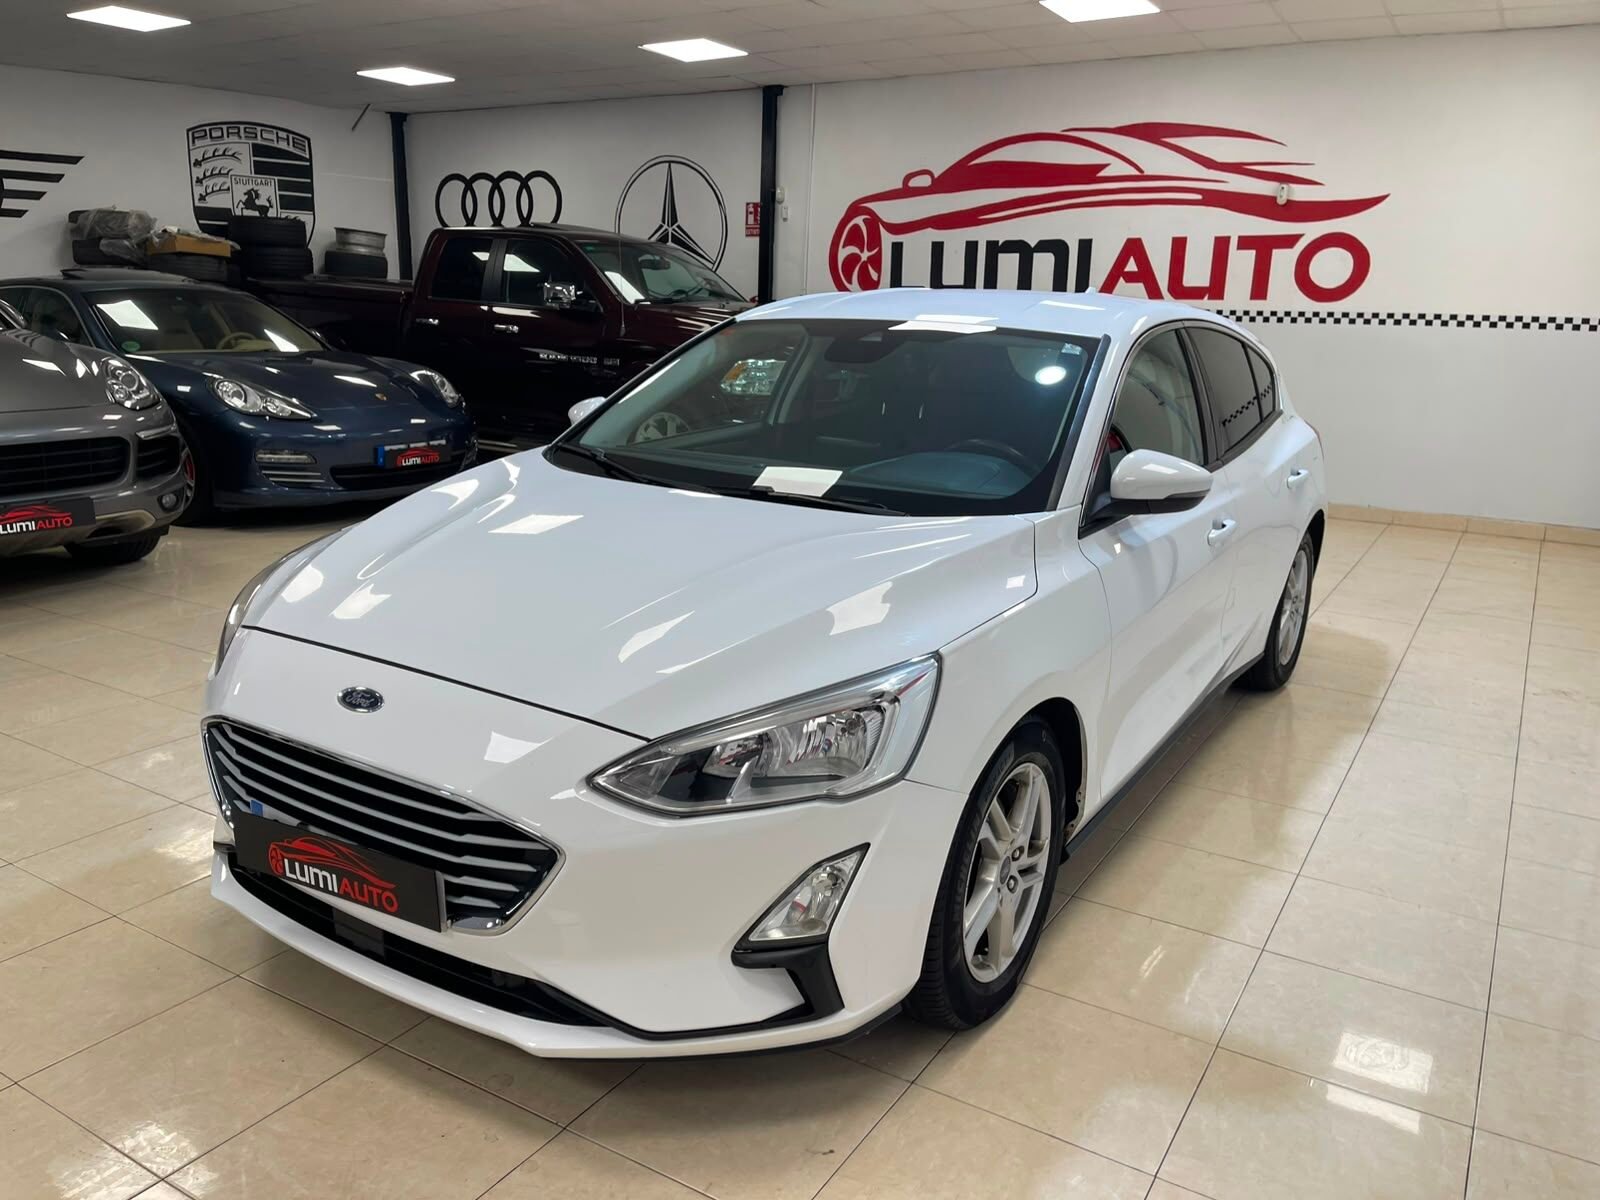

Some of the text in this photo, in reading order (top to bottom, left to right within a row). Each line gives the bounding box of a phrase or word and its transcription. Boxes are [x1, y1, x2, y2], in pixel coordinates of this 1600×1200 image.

[191, 126, 307, 153] PORSCHE
[233, 177, 272, 187] STUTTGART
[345, 692, 375, 707] Ford
